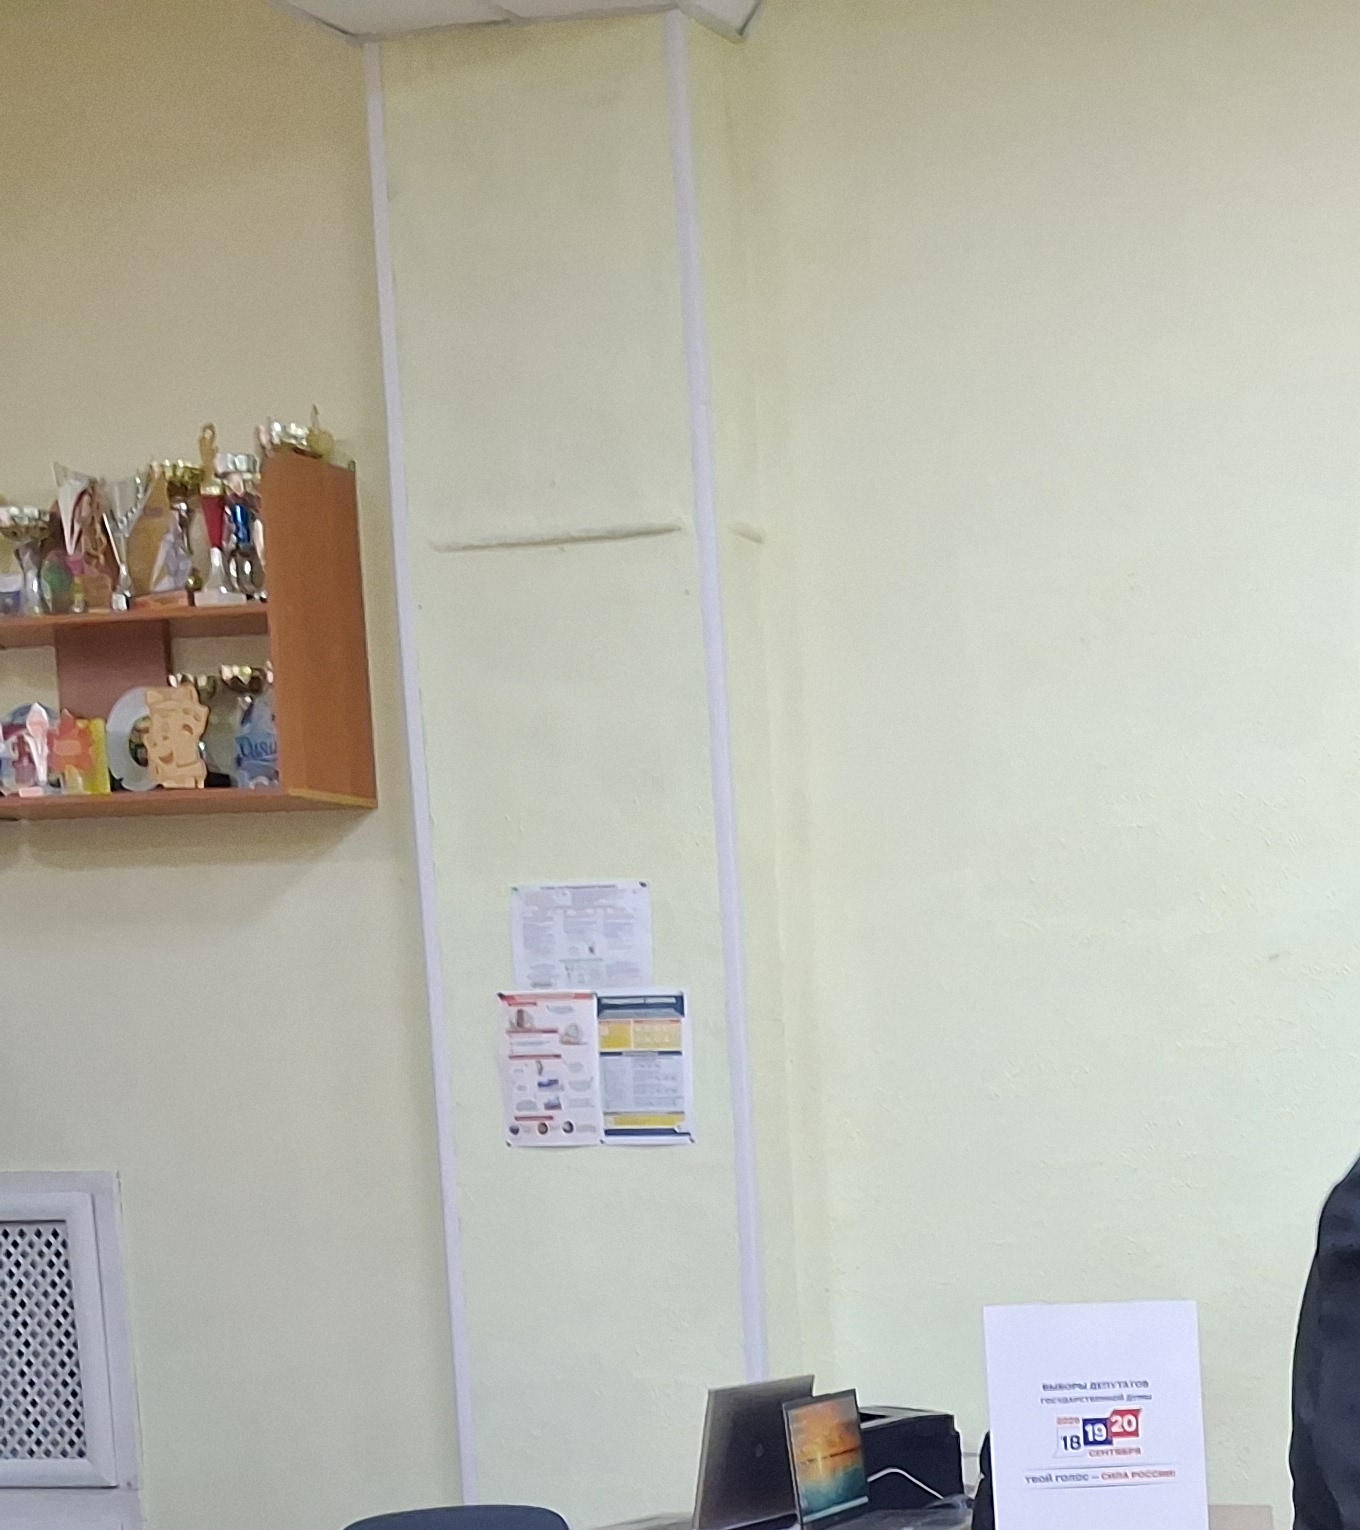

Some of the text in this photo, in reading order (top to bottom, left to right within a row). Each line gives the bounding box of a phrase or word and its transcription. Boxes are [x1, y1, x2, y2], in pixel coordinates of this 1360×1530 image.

[1042, 1380, 1149, 1392] ВЫБОРЫ ДЕПУТАТОВ
[1062, 1415, 1137, 1451] 18 19 20
